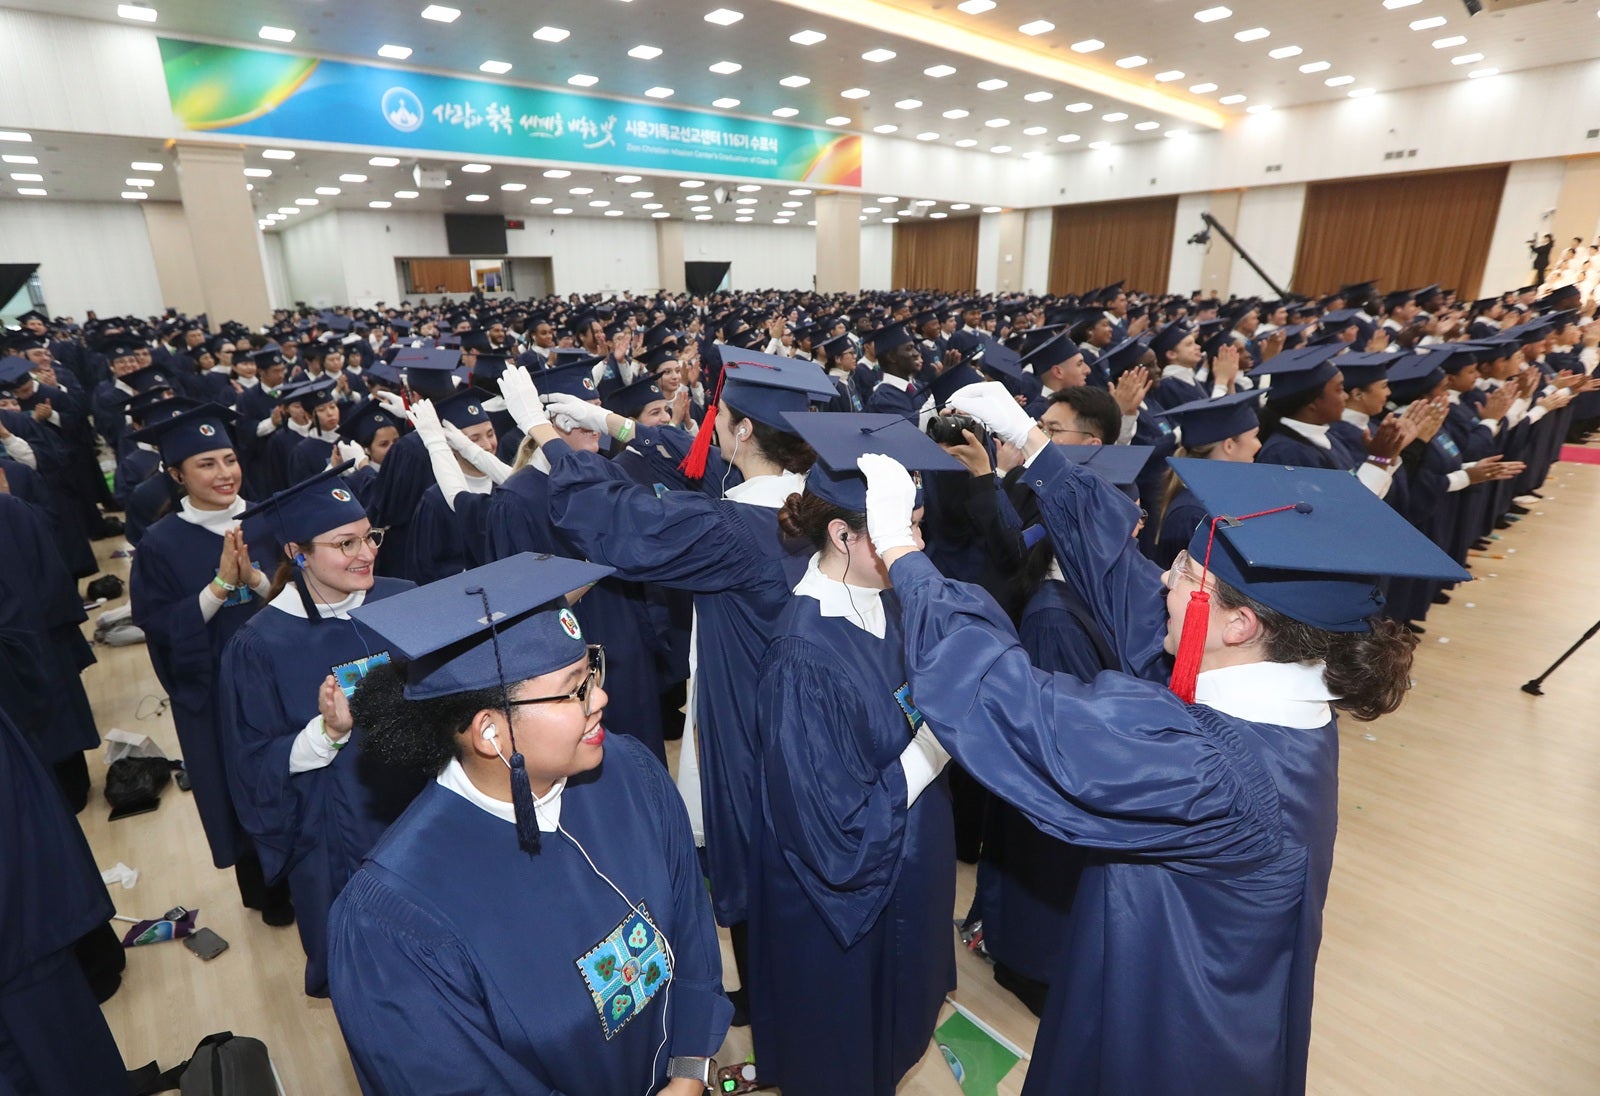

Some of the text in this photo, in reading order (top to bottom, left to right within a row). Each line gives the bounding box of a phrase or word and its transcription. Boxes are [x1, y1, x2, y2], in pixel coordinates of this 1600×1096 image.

[625, 120, 778, 153] 시온기독교선교센터 116기 수료식
